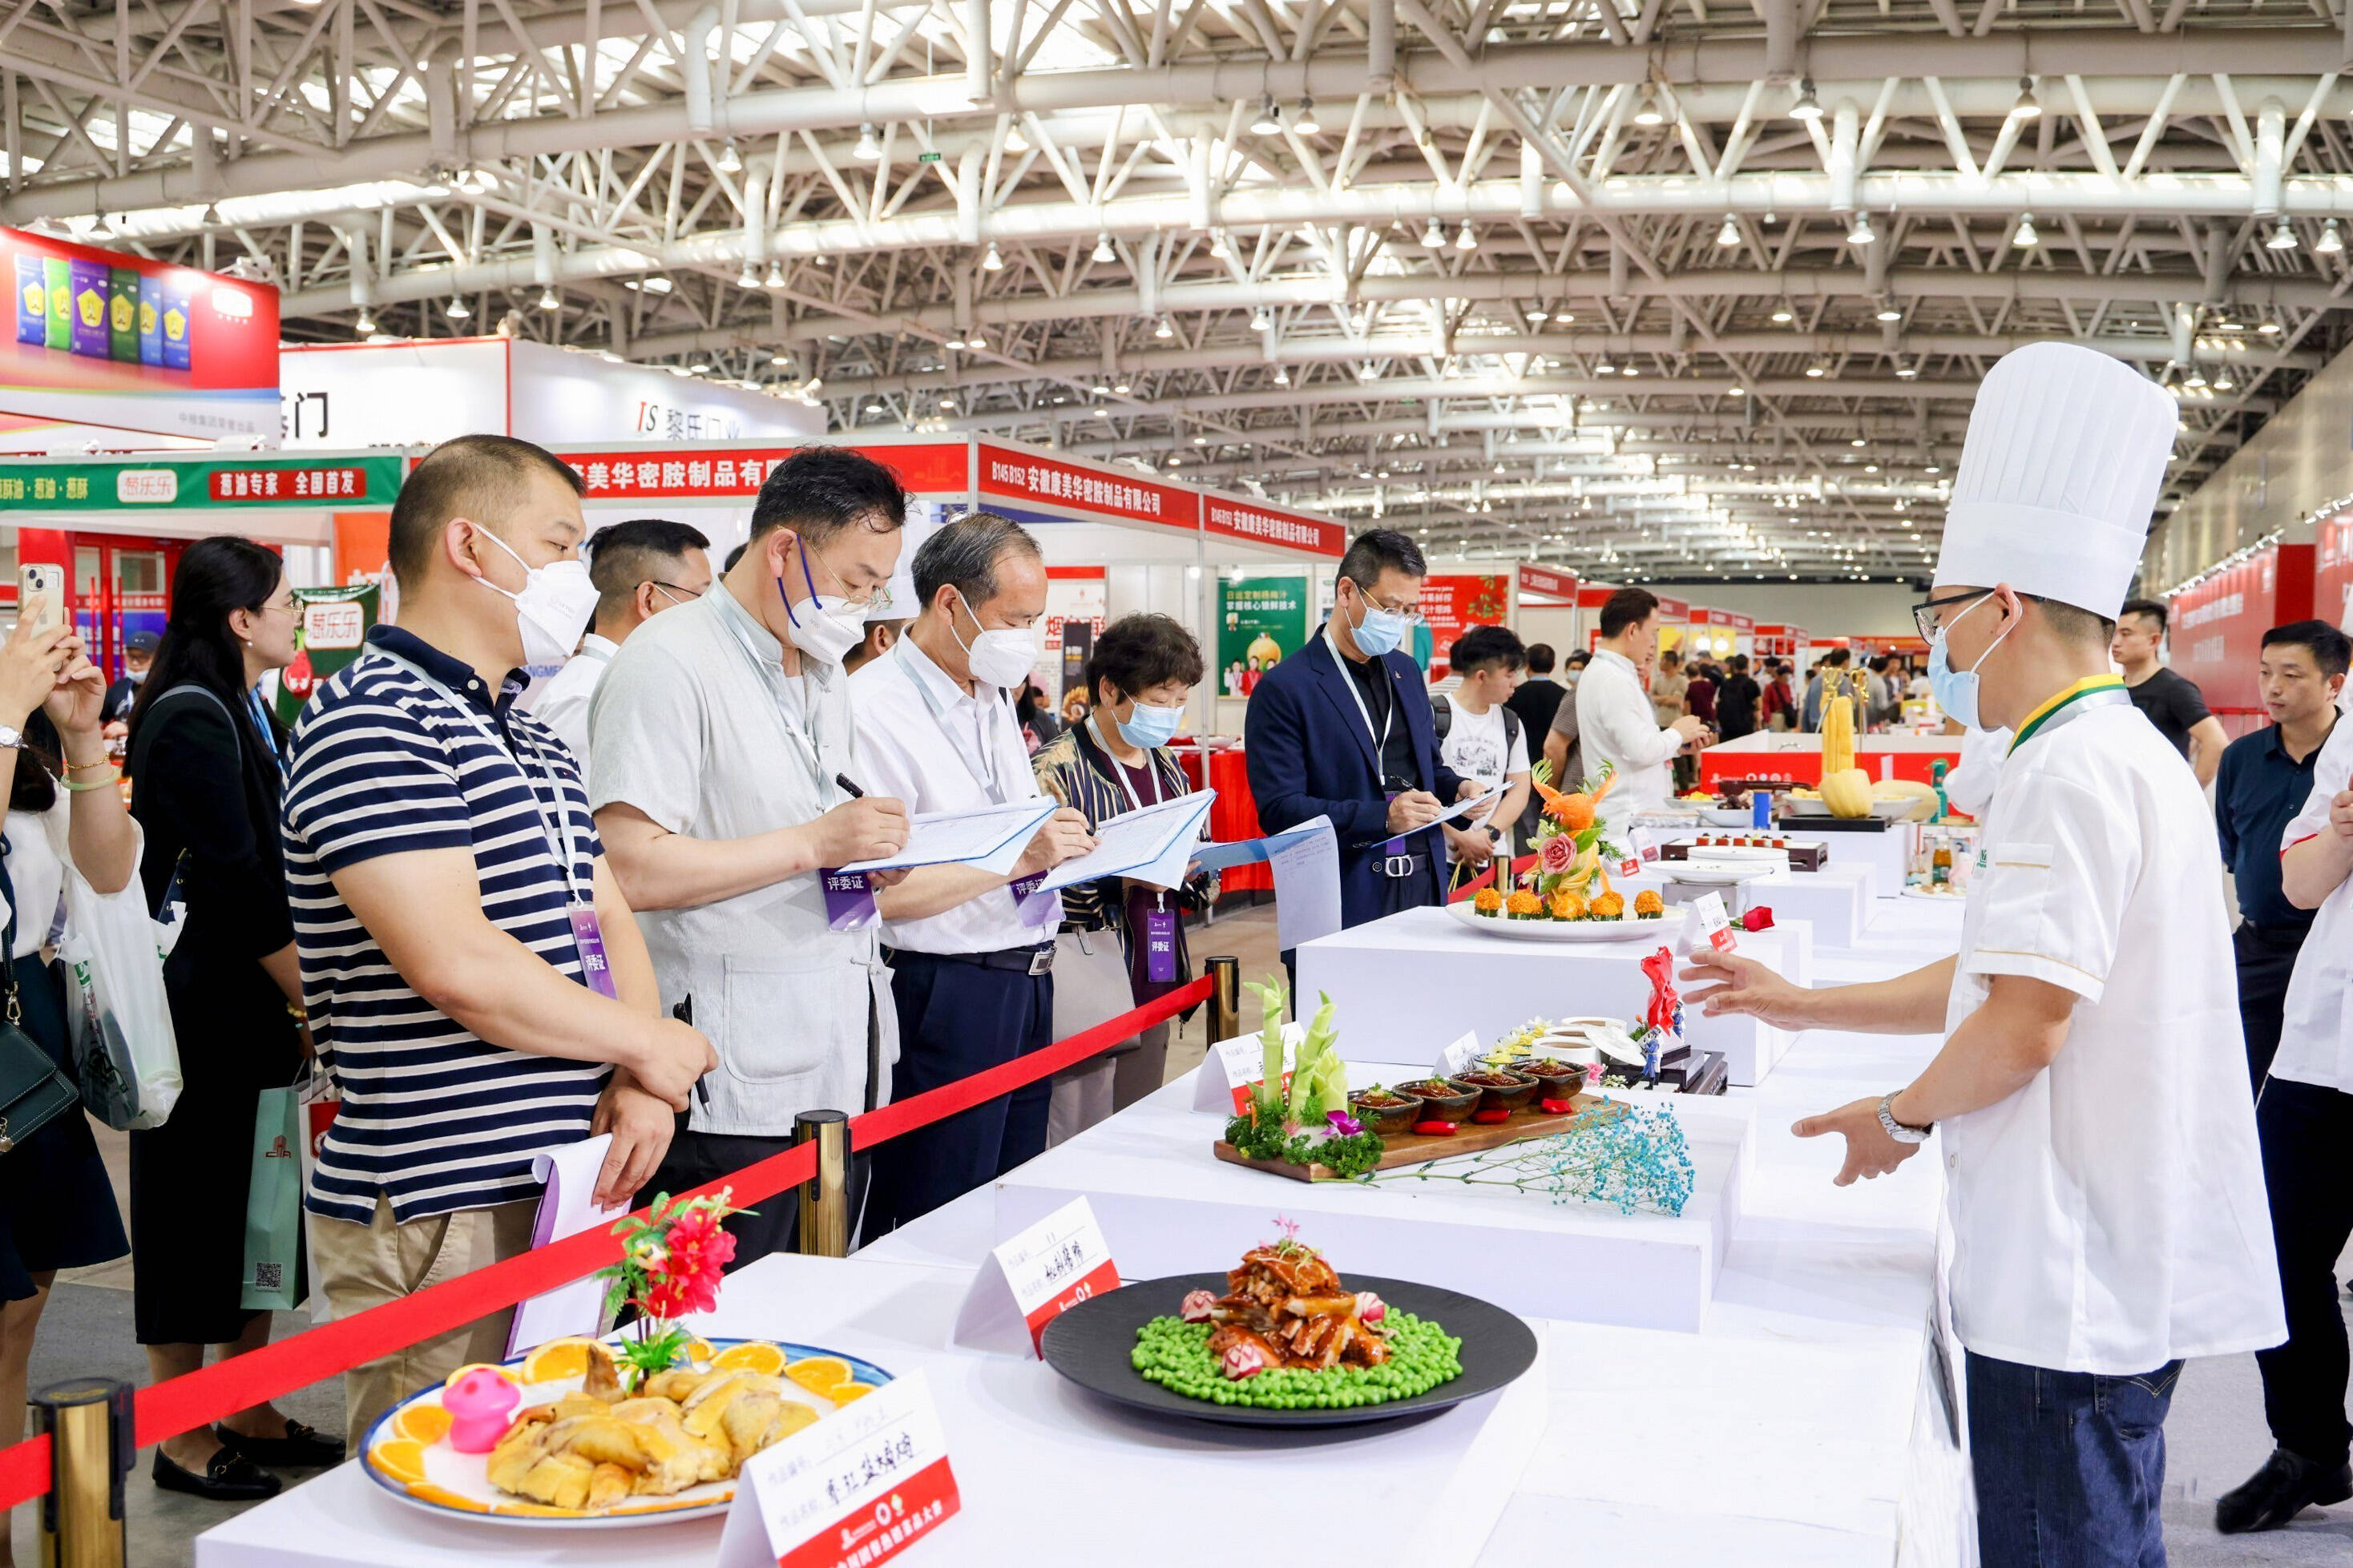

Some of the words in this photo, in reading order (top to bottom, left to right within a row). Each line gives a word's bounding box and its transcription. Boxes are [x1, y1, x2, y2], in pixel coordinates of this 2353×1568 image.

[295, 470, 355, 495] 全国首发
[1027, 466, 1161, 516] 安徽康美华密胺制品有限公司
[827, 875, 864, 892] 评委证
[1152, 941, 1169, 952] 评委证
[584, 954, 606, 971] 评委证
